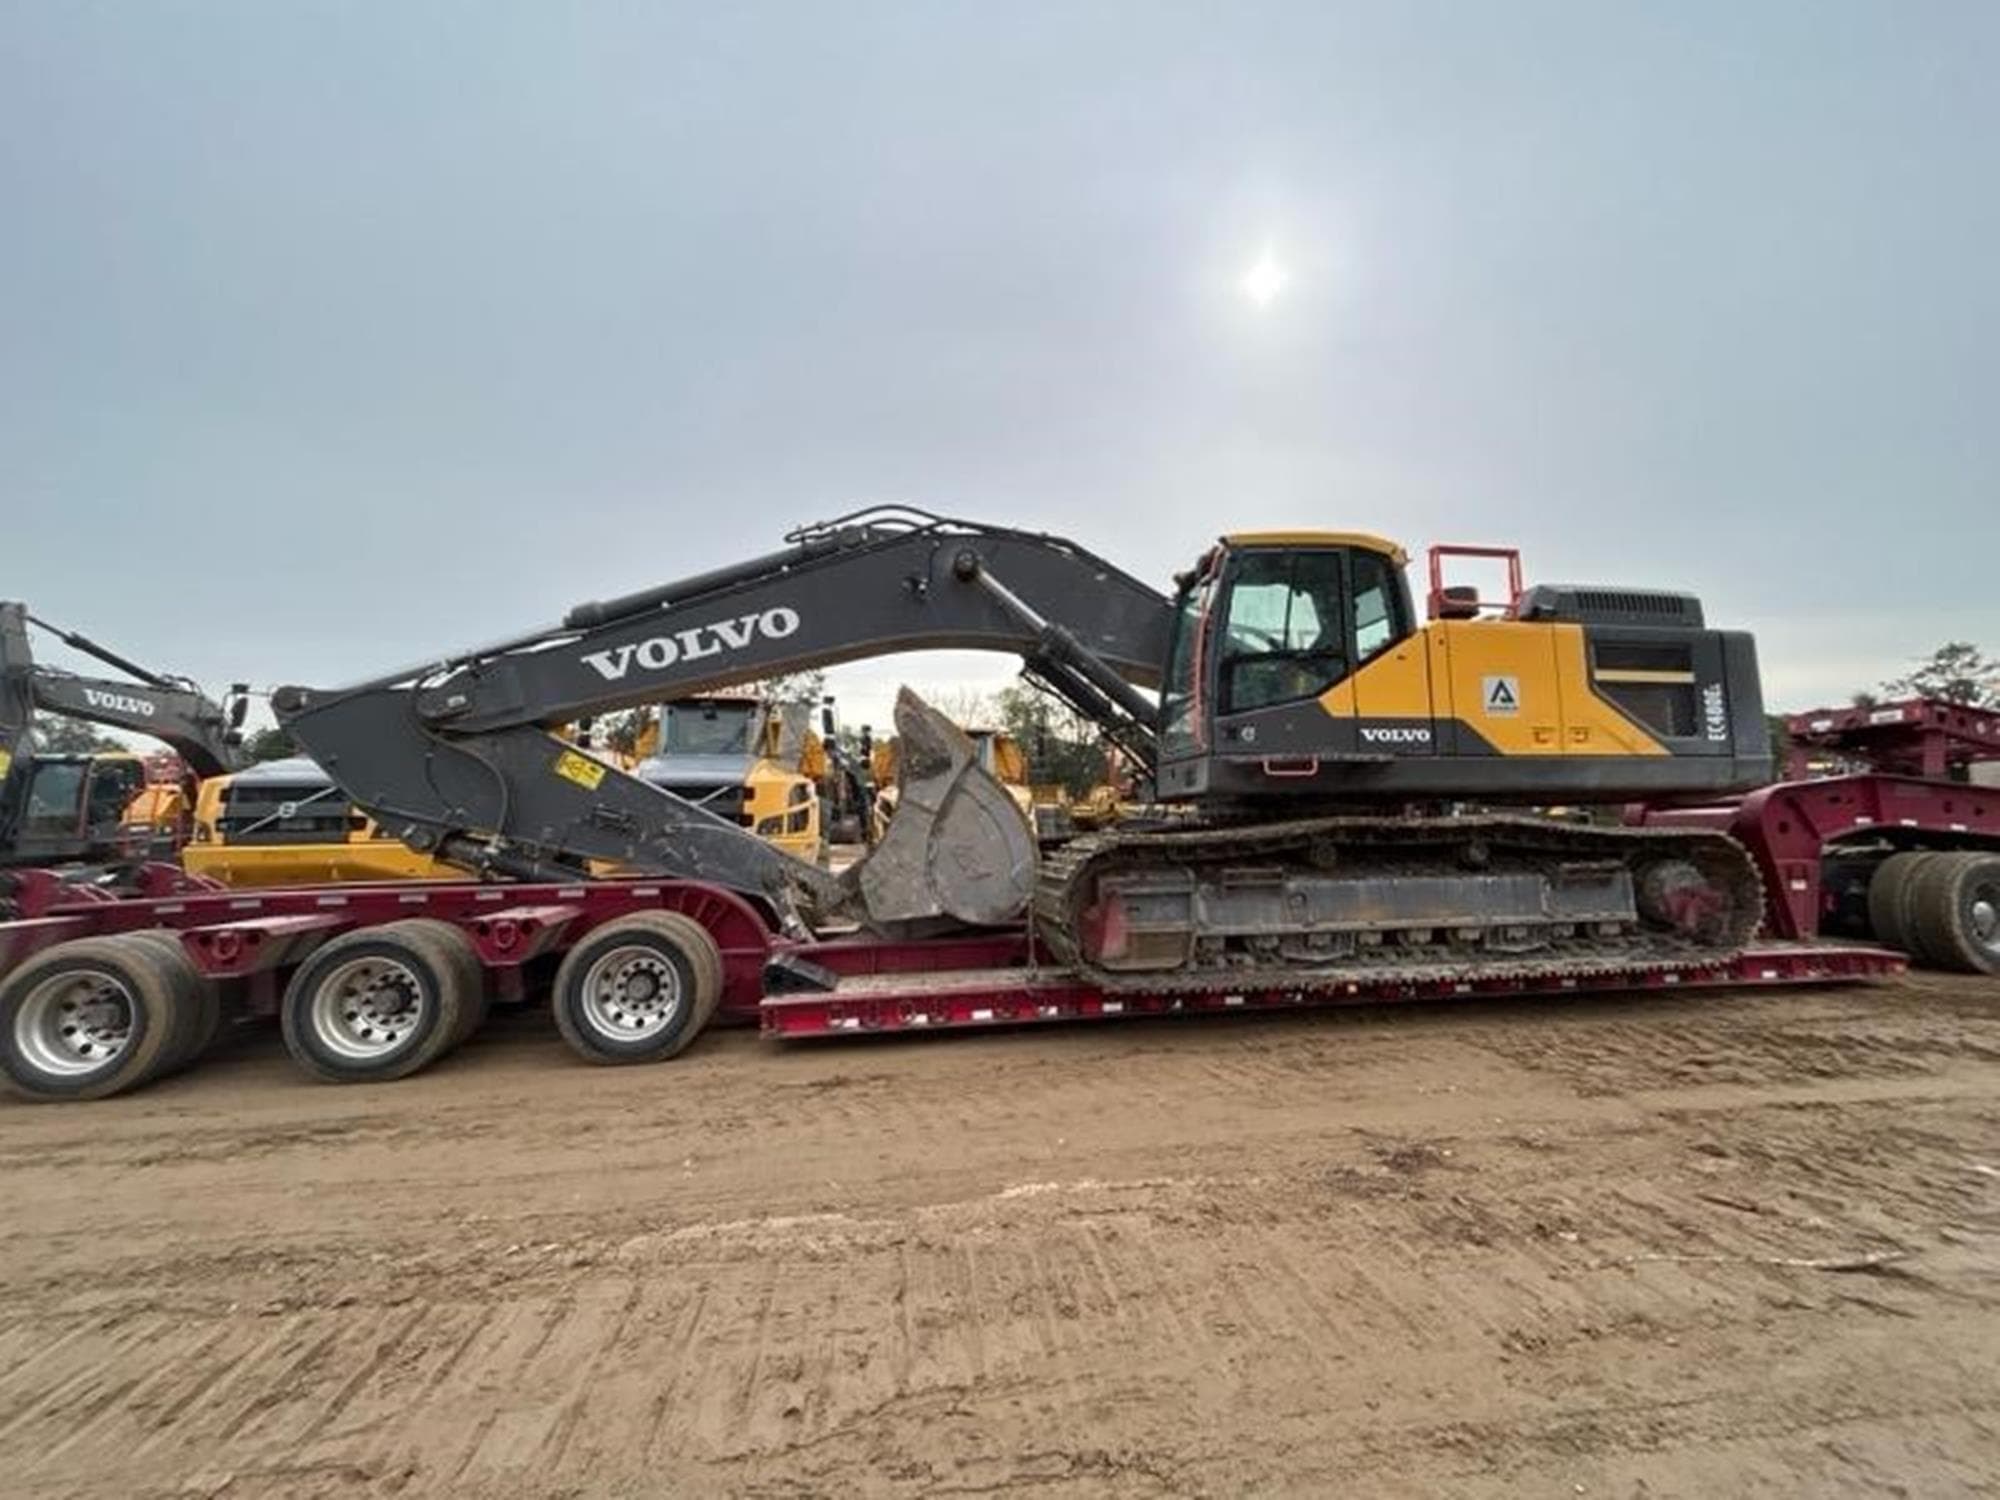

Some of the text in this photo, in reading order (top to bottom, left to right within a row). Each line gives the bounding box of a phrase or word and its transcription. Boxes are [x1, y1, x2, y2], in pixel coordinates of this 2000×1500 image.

[580, 607, 800, 680] VOLVO
[82, 689, 154, 716] VOLVO
[1360, 728, 1431, 742] VOLVO
